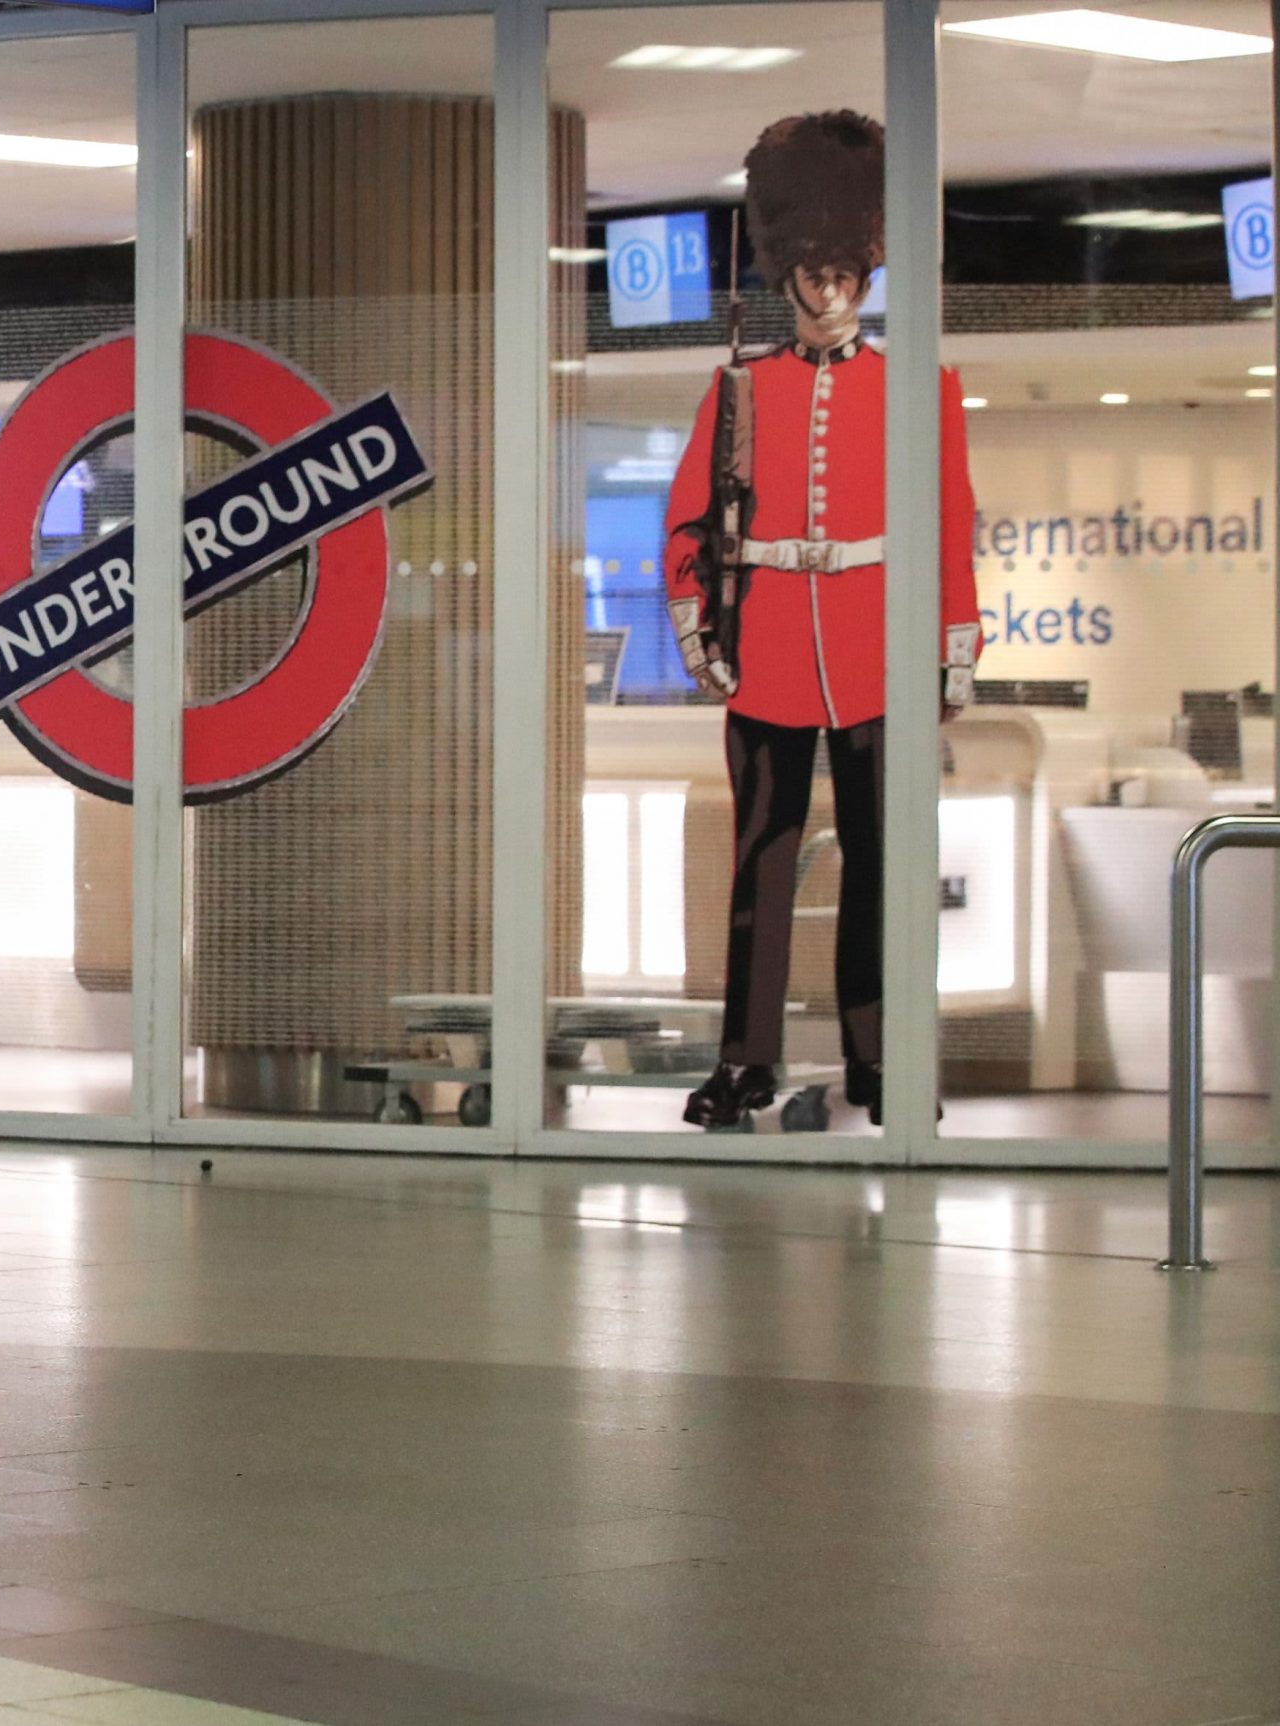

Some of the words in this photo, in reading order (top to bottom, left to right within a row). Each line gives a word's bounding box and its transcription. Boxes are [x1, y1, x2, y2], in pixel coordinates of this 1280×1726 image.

[672, 231, 706, 277] 13
[973, 497, 1264, 556] ternational
[979, 591, 1113, 645] ckets
